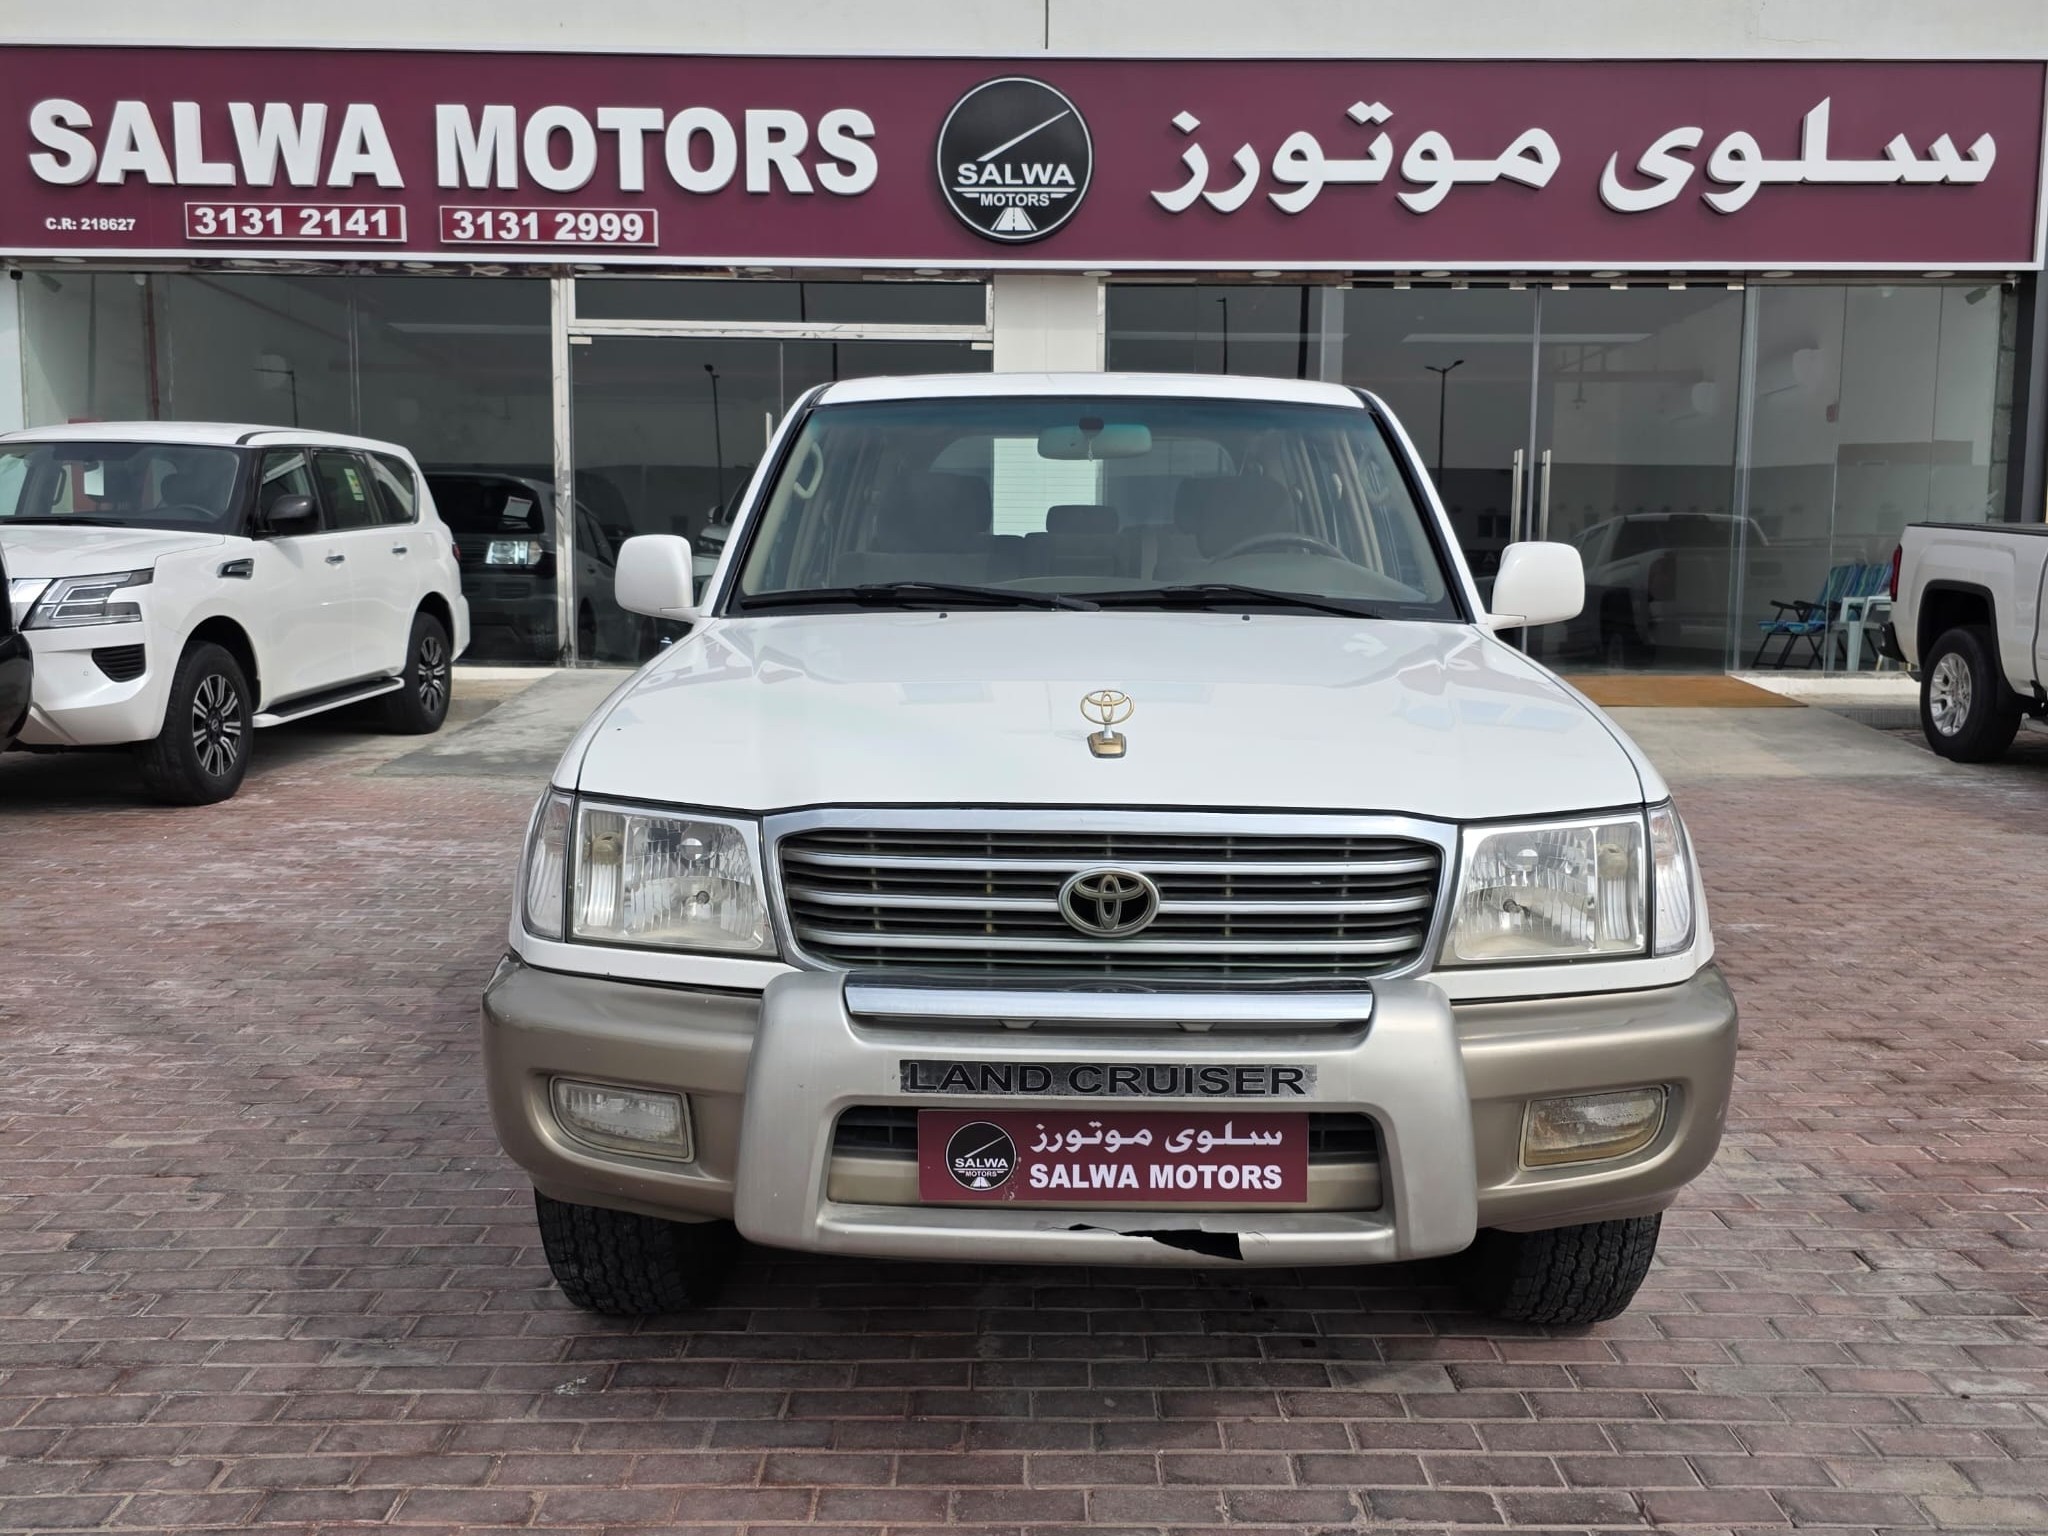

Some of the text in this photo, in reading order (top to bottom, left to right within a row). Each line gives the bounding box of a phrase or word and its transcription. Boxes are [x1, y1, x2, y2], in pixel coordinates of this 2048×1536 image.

[29, 99, 879, 195] SALWA MOTORS
[1150, 96, 1997, 215] سلوى موتورز
[957, 163, 1076, 185] SALWA
[980, 193, 1050, 207] MOTORS
[45, 217, 136, 231] C.R: 218627
[194, 207, 389, 236] 3131 2141
[452, 210, 645, 242] 3131 2999
[908, 1062, 1307, 1096] LAND CRUISER
[1030, 1120, 1284, 1153] سلوى موتورز
[955, 1157, 1009, 1168] SALWA
[965, 1170, 998, 1178] MOTORS
[1029, 1163, 1283, 1190] SALWA MOTORS
